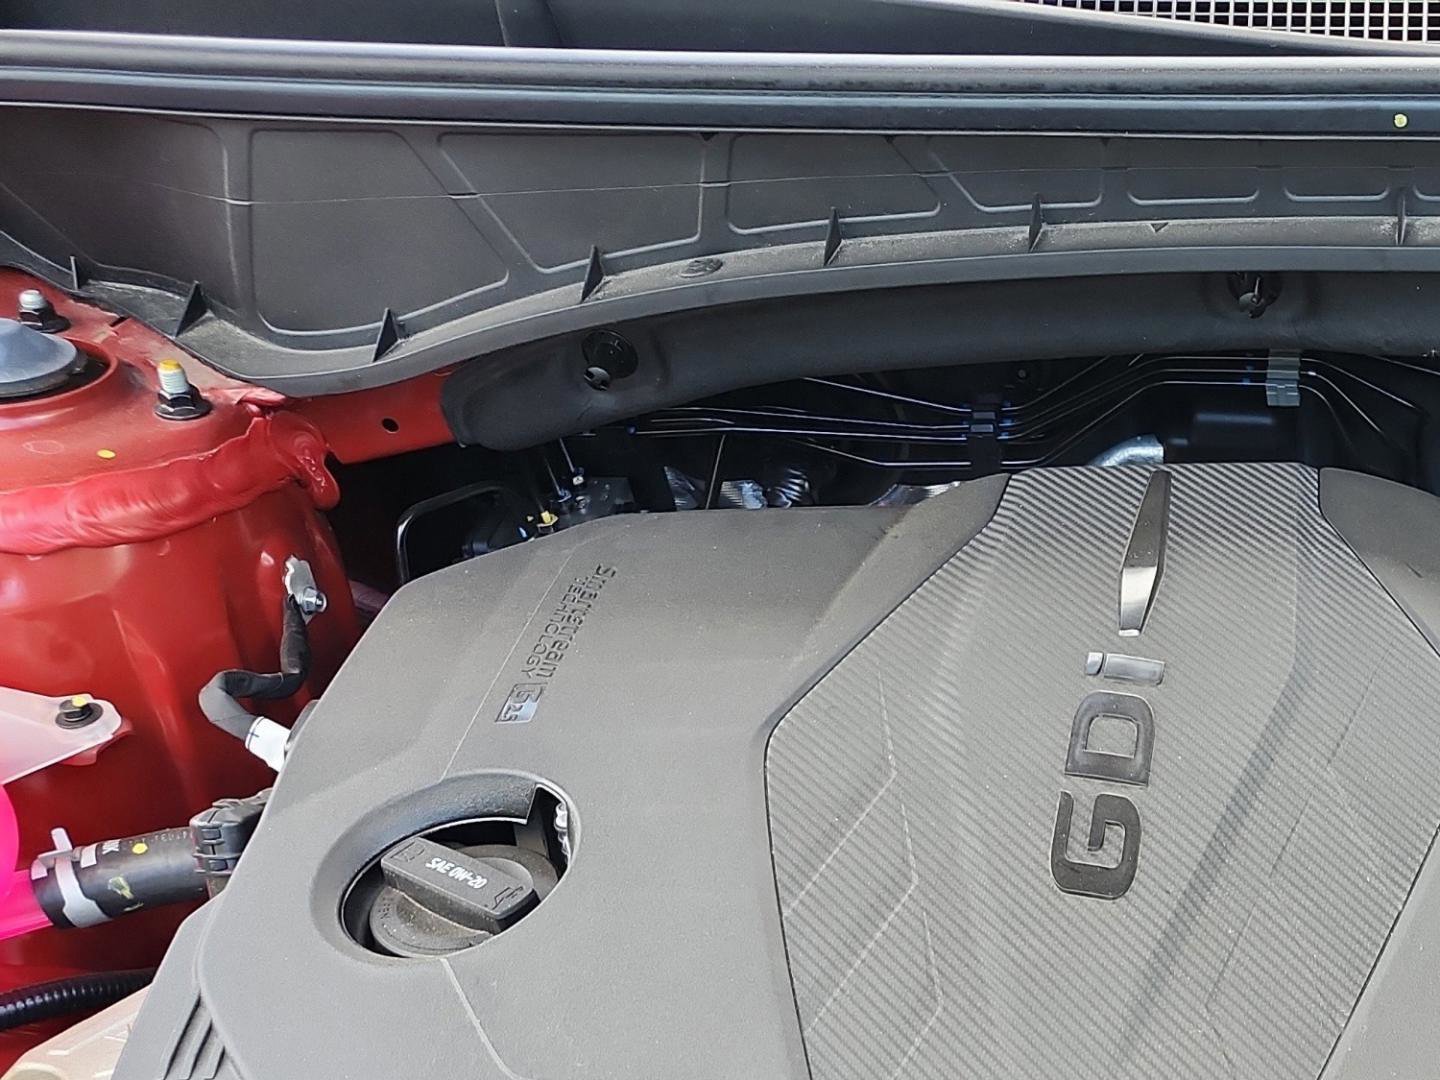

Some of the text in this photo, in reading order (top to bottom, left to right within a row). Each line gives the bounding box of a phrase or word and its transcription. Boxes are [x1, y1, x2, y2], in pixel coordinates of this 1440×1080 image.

[521, 576, 589, 679] TECHNOLOGY
[535, 563, 617, 679] Smartstream
[1050, 651, 1166, 900] GDi
[425, 856, 488, 890] SAE 0W-20
